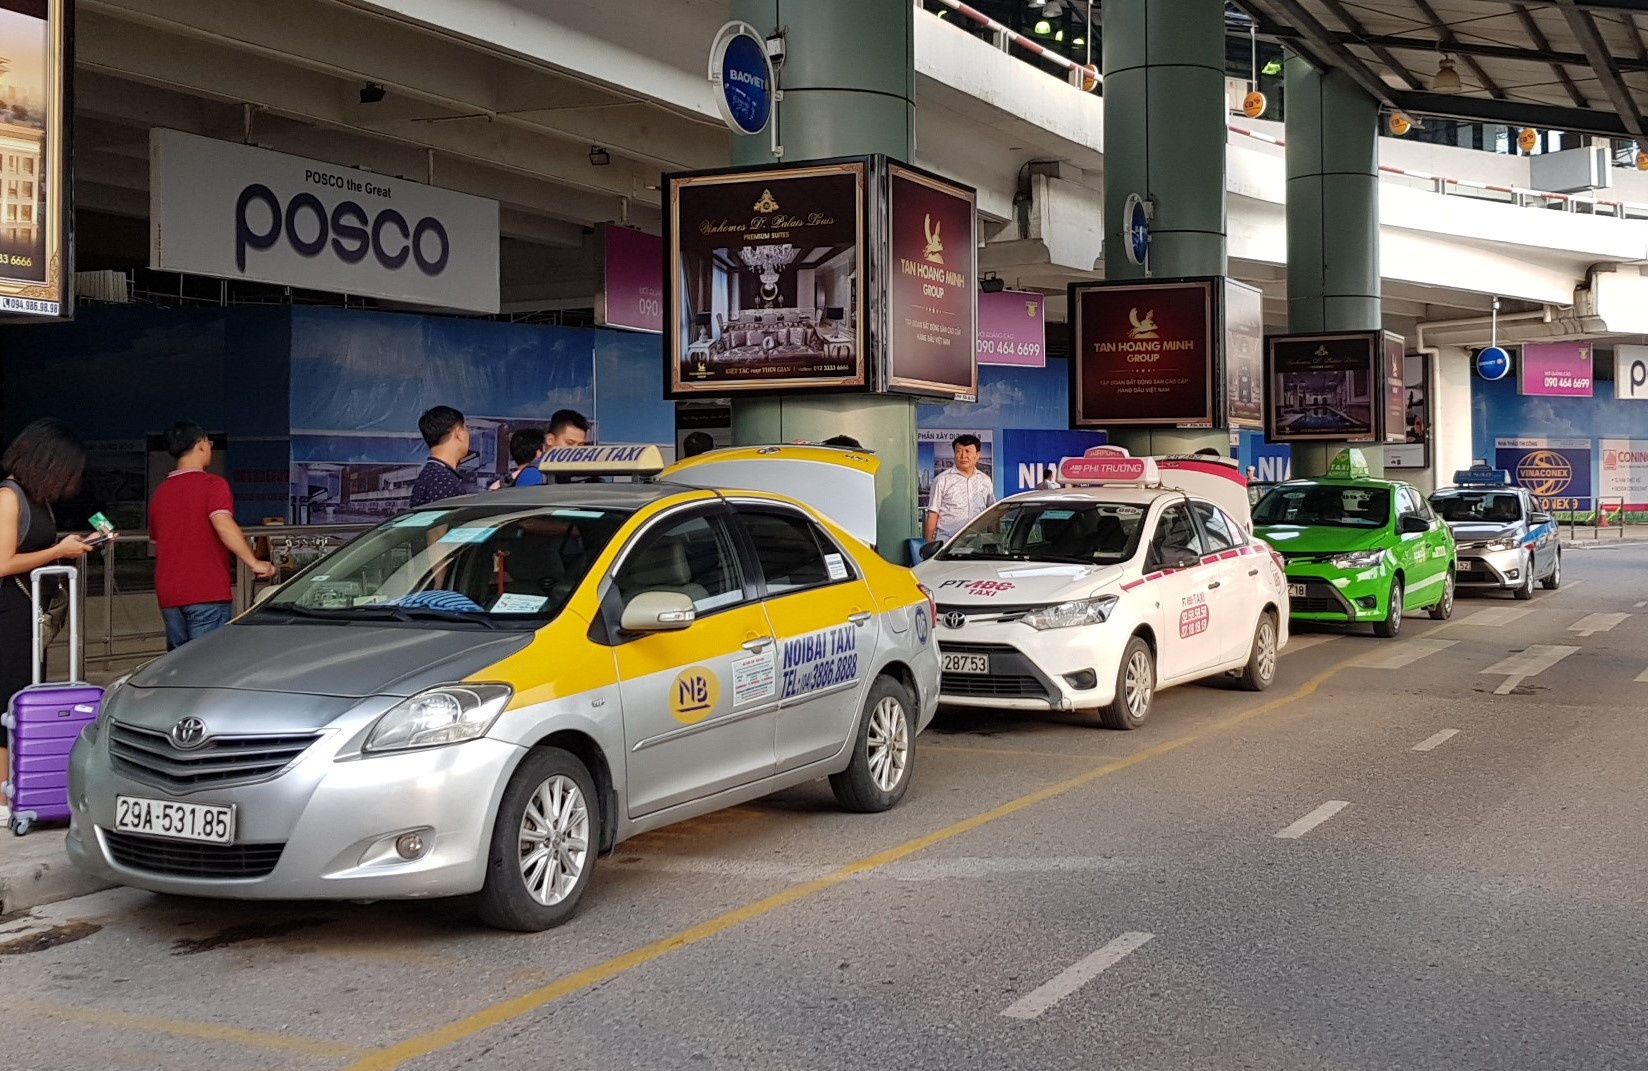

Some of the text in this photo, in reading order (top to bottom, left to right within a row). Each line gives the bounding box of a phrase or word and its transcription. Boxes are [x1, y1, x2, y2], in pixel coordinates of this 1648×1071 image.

[305, 169, 392, 198] POSCO the Great
[235, 183, 450, 277] posco
[743, 231, 790, 241] PREMIUM SUITES
[10, 255, 32, 267] 6666
[900, 259, 965, 288] TAN HOANG MINH
[923, 283, 945, 299] GROUP
[639, 298, 659, 316] 090
[978, 340, 1041, 357] 090 464 6699
[1093, 340, 1194, 353] TAN HOANG MINH
[1126, 353, 1160, 363] GROUP
[1544, 377, 1590, 389] 090 464 6699
[543, 447, 646, 462] NOIBAI TAXI
[1083, 464, 1099, 473] PHI
[1520, 469, 1568, 477] VINACONEX
[968, 589, 997, 597] TAXI
[783, 625, 856, 670] NOIBAI TAXI
